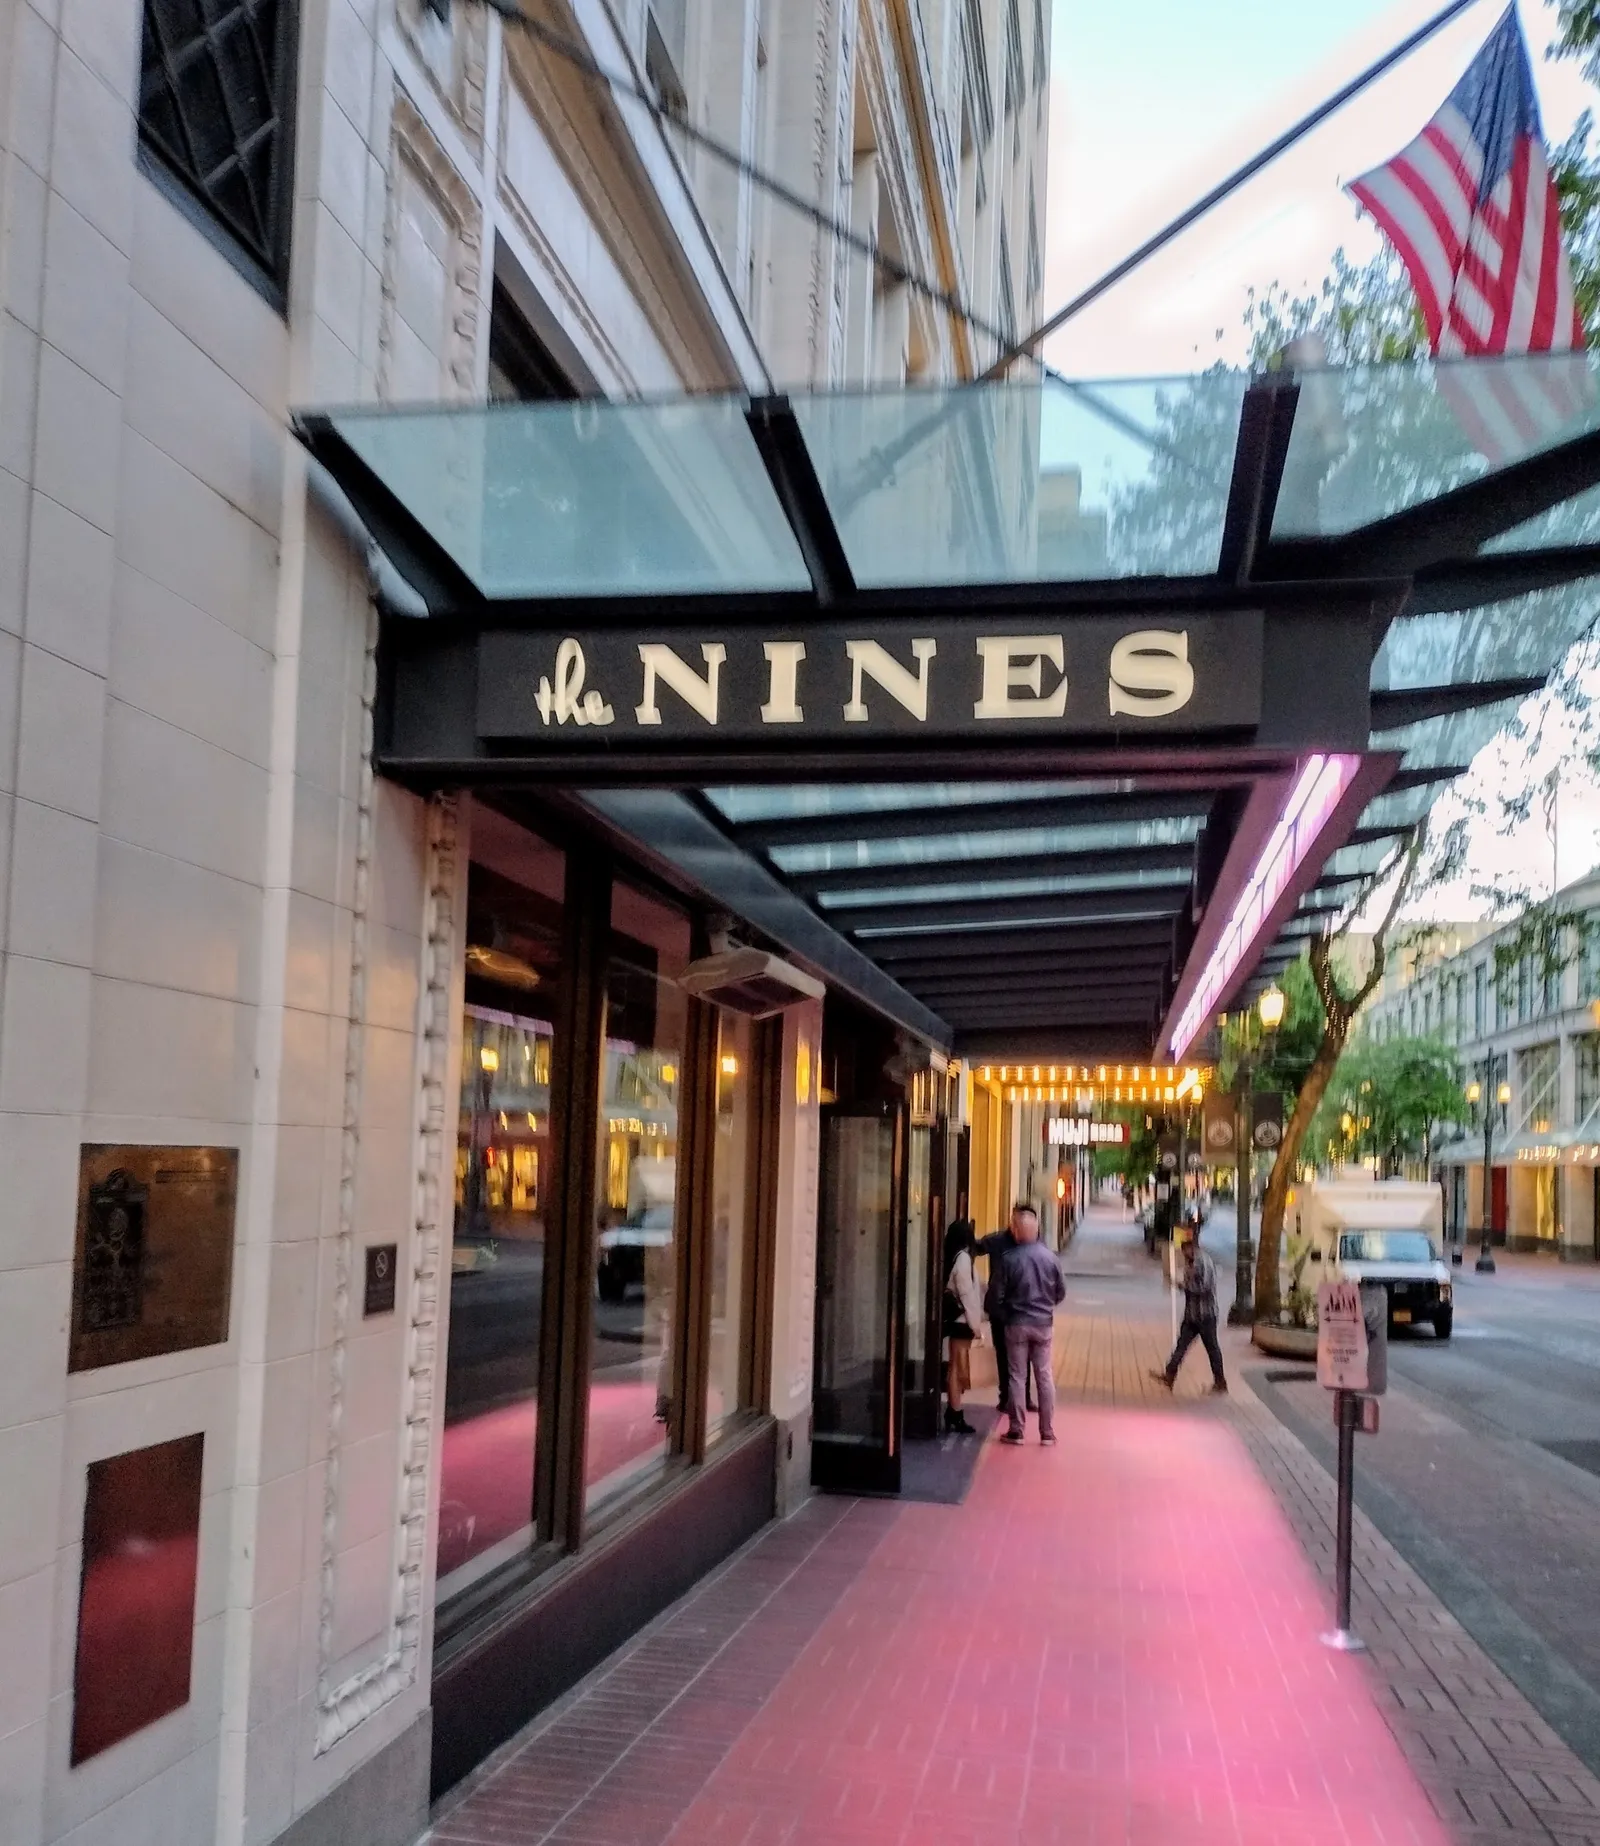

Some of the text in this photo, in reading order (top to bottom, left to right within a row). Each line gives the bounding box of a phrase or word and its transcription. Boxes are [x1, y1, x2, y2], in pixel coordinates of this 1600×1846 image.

[533, 630, 1196, 727] the NINES
[1048, 1117, 1089, 1146] MUJI
